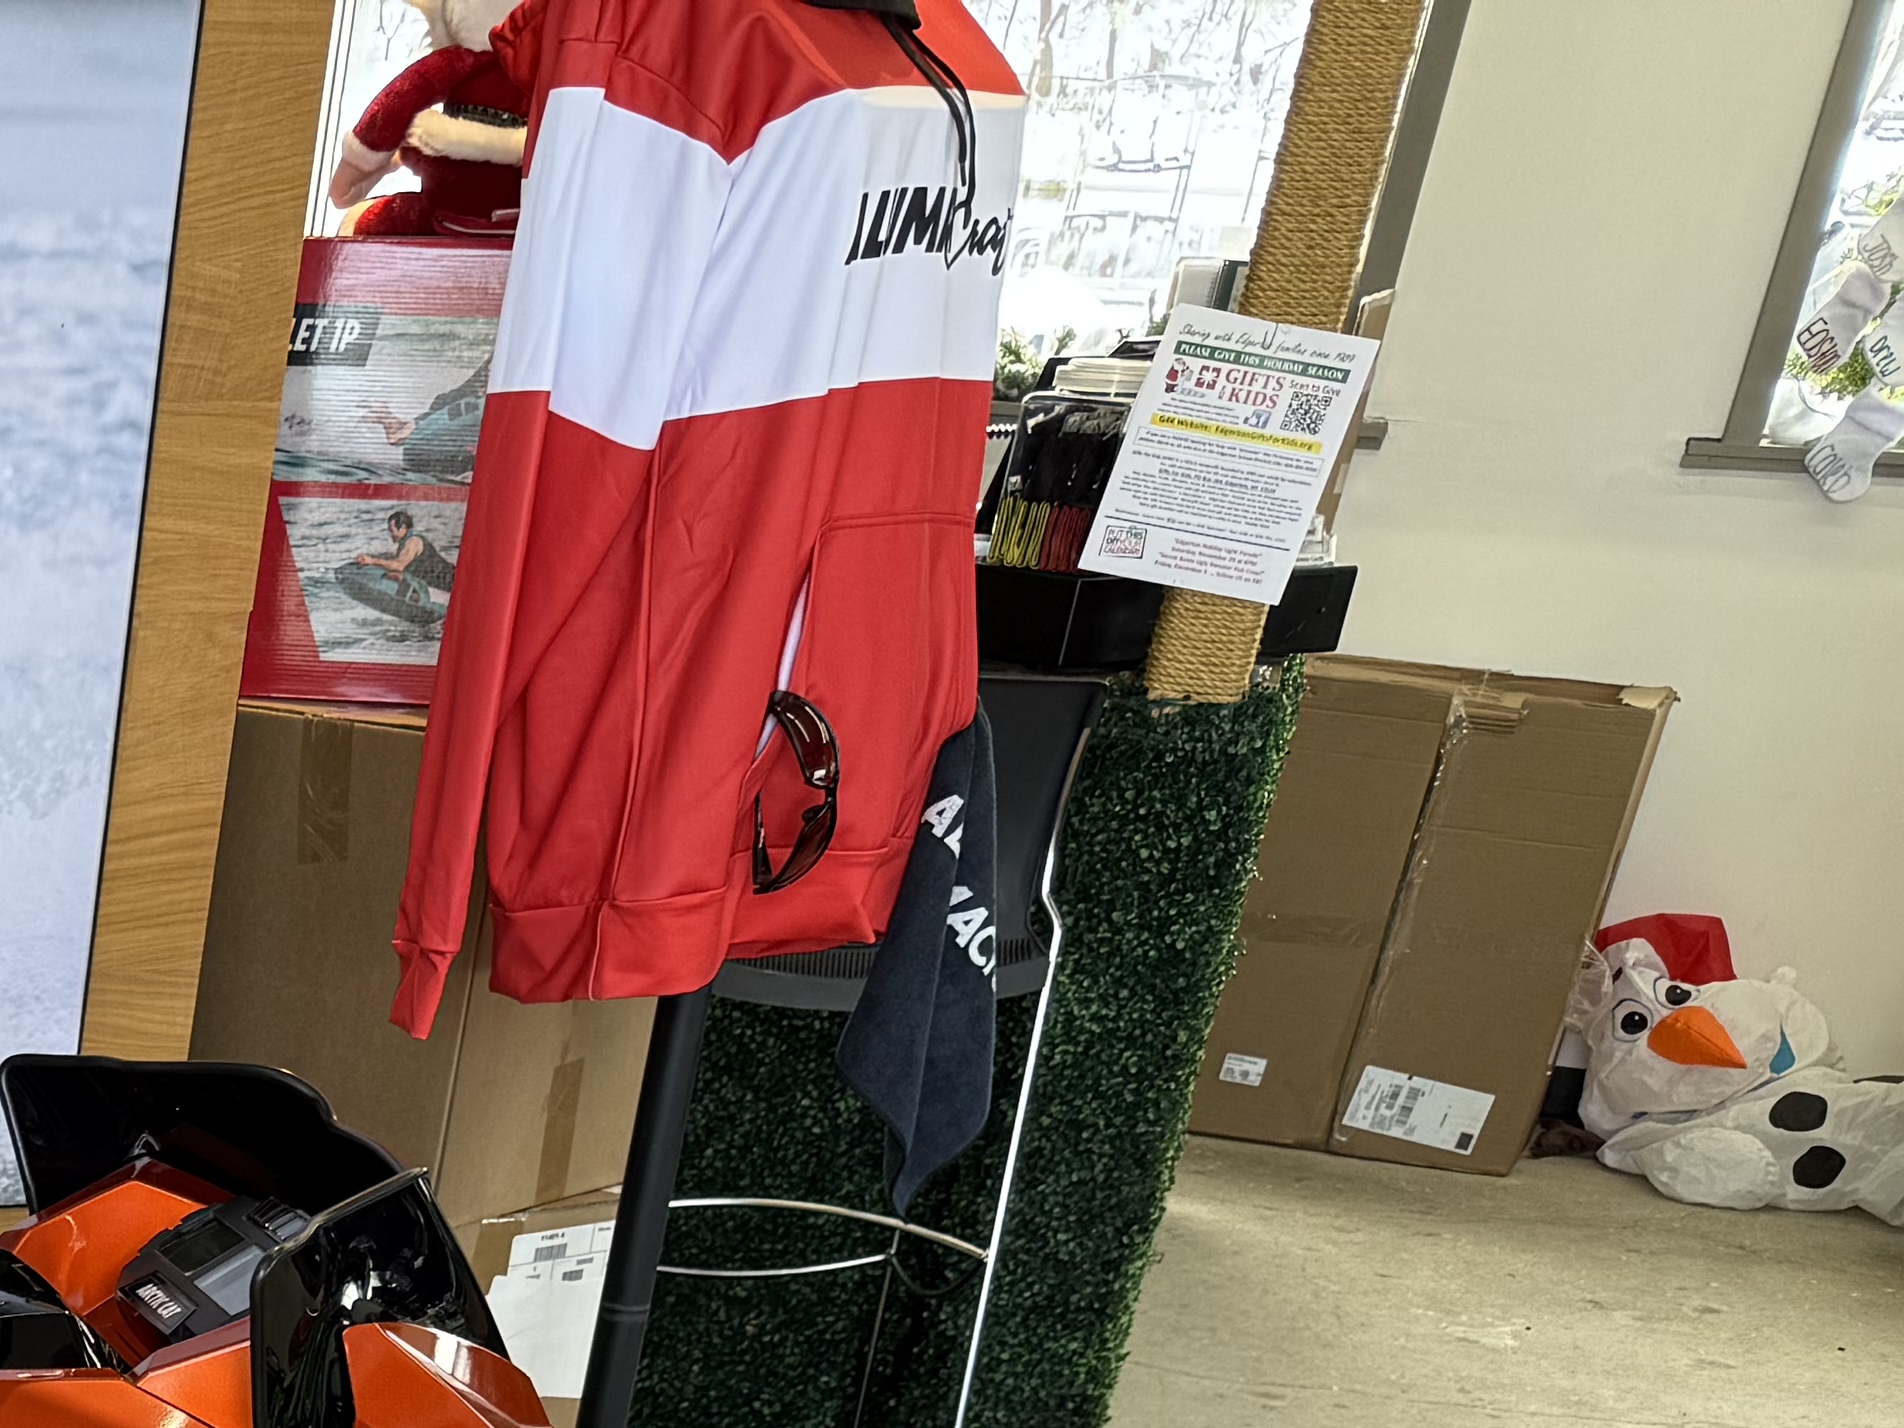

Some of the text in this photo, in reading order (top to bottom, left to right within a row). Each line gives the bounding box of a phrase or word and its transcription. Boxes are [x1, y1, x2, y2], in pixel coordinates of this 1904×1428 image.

[1178, 342, 1344, 380] PLEASE GIVE THIS HOLIDAY SEASON
[1223, 367, 1287, 392] GIFTS
[1310, 383, 1321, 393] to
[1321, 386, 1341, 396] Give
[1227, 386, 1280, 409] KIDS
